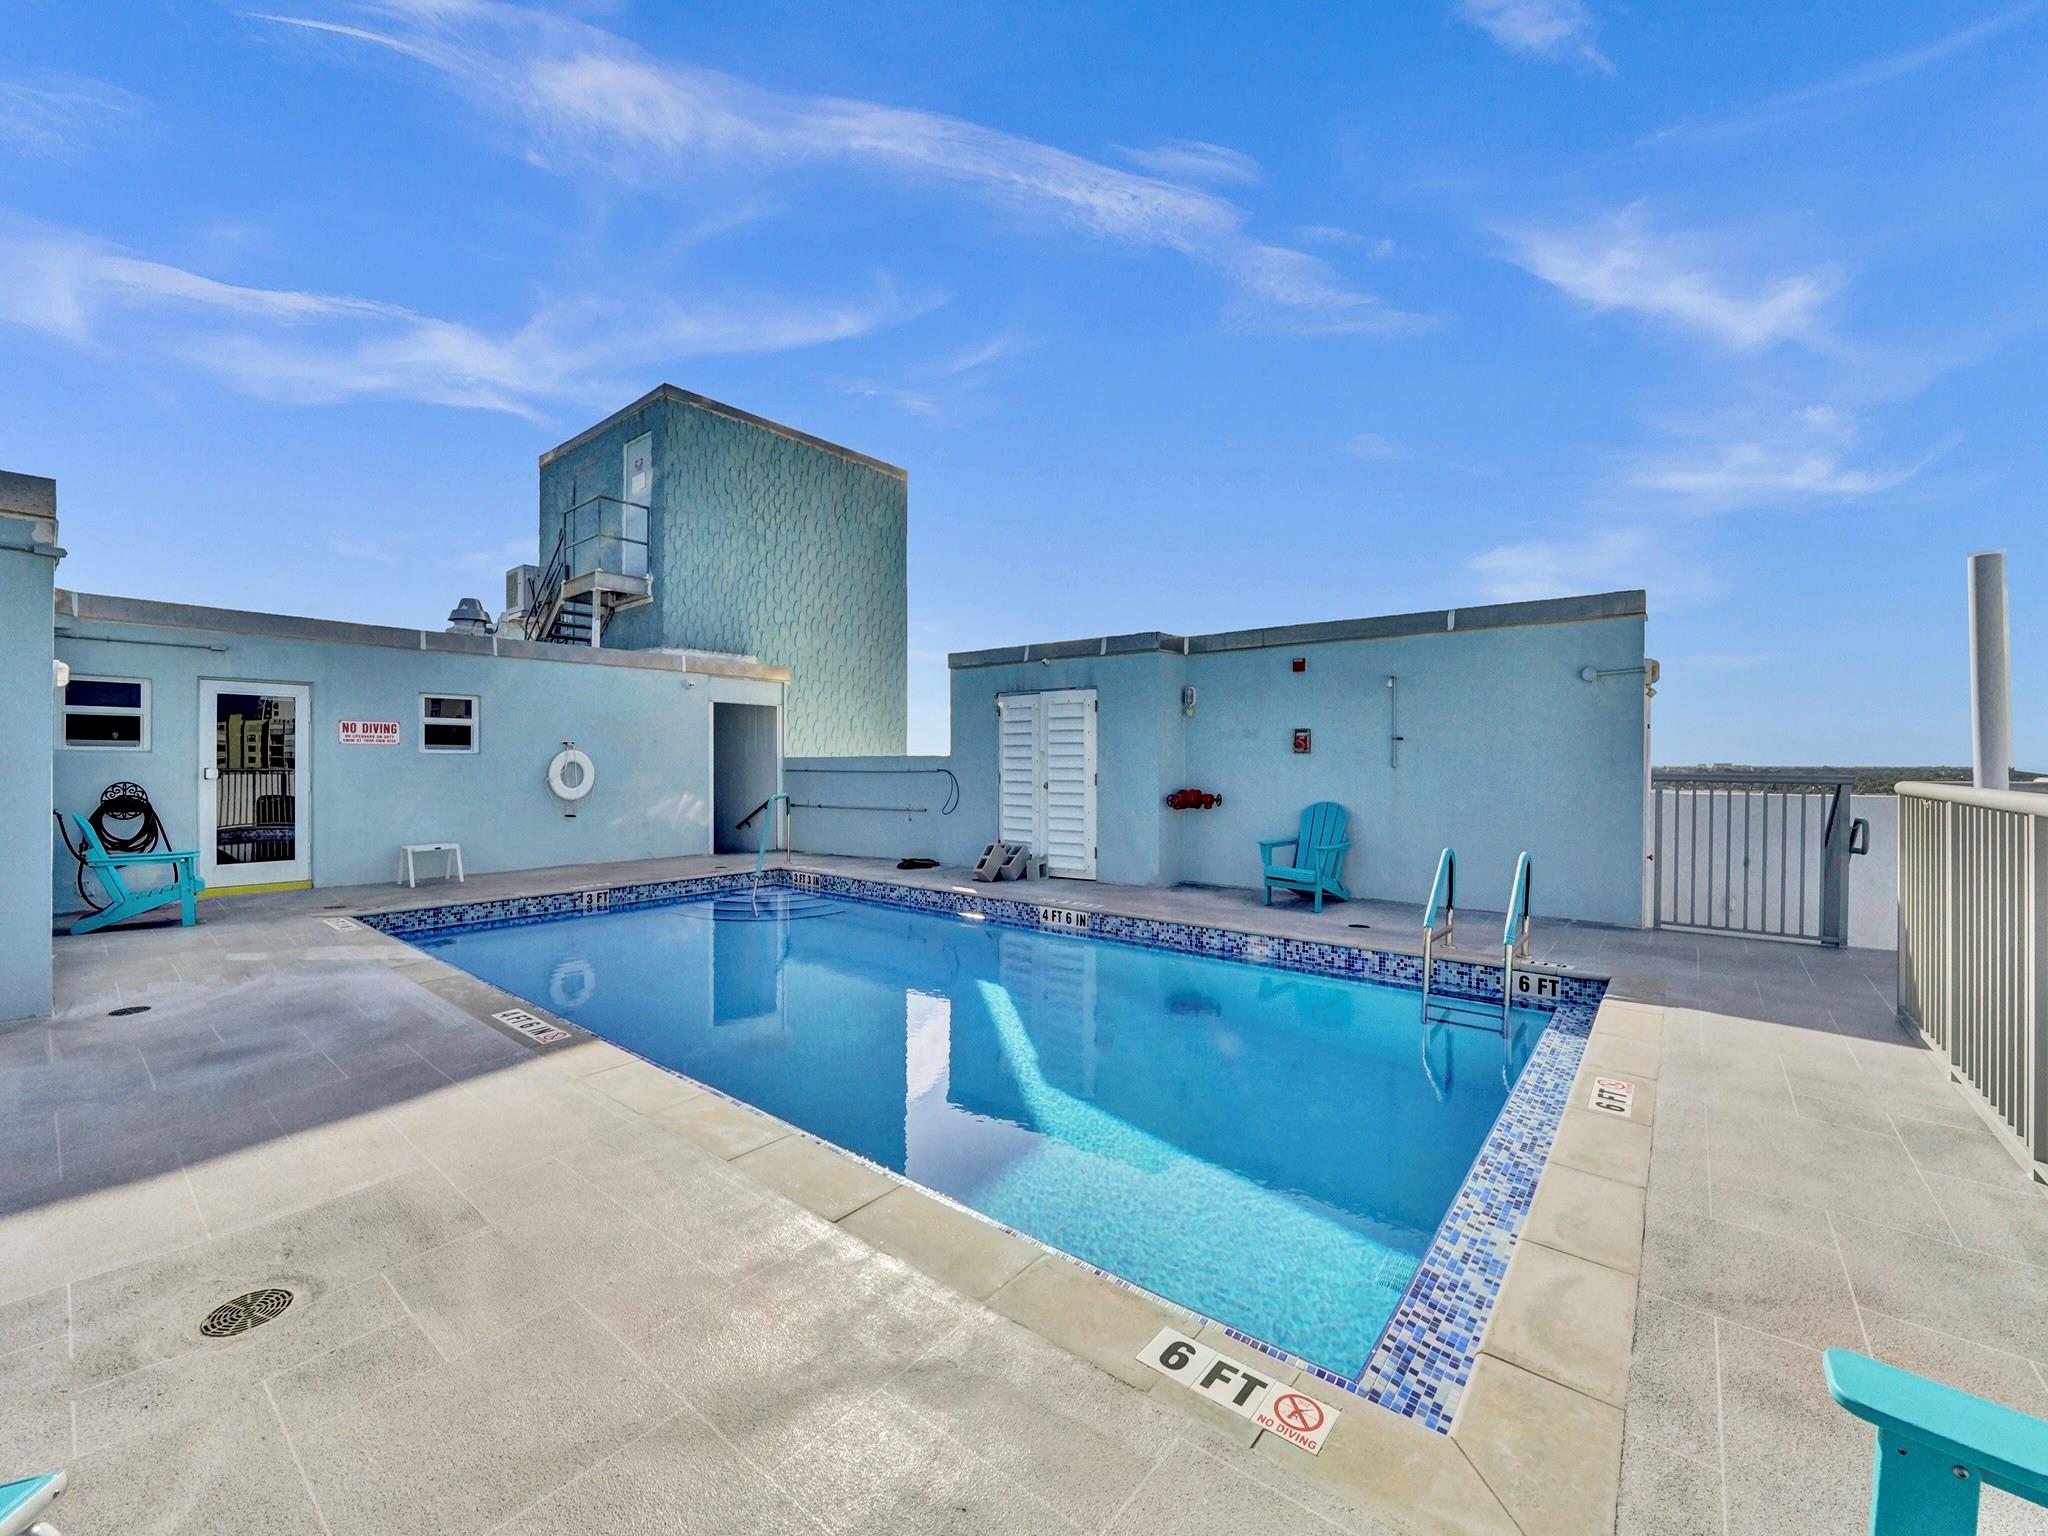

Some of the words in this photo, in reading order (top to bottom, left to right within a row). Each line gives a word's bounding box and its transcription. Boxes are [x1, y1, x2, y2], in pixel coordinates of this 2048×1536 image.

[342, 722, 357, 733] NO
[362, 723, 397, 734] DIVING
[794, 873, 798, 882] 3
[799, 874, 806, 884] FT
[807, 875, 811, 884] 3
[813, 876, 819, 886] IN
[586, 894, 593, 904] 3
[596, 891, 608, 903] FT
[1042, 909, 1048, 921] 4
[1051, 910, 1062, 923] FT
[1066, 912, 1072, 924] 6
[1076, 913, 1086, 927] IN
[1519, 975, 1530, 992] 6
[1538, 978, 1559, 997] FT
[1597, 1088, 1627, 1104] FT
[1595, 1102, 1626, 1112] 6
[1159, 1341, 1196, 1370] 6
[1199, 1360, 1268, 1406] FT
[1256, 1414, 1274, 1428] NO
[1276, 1423, 1318, 1450] DIVING
